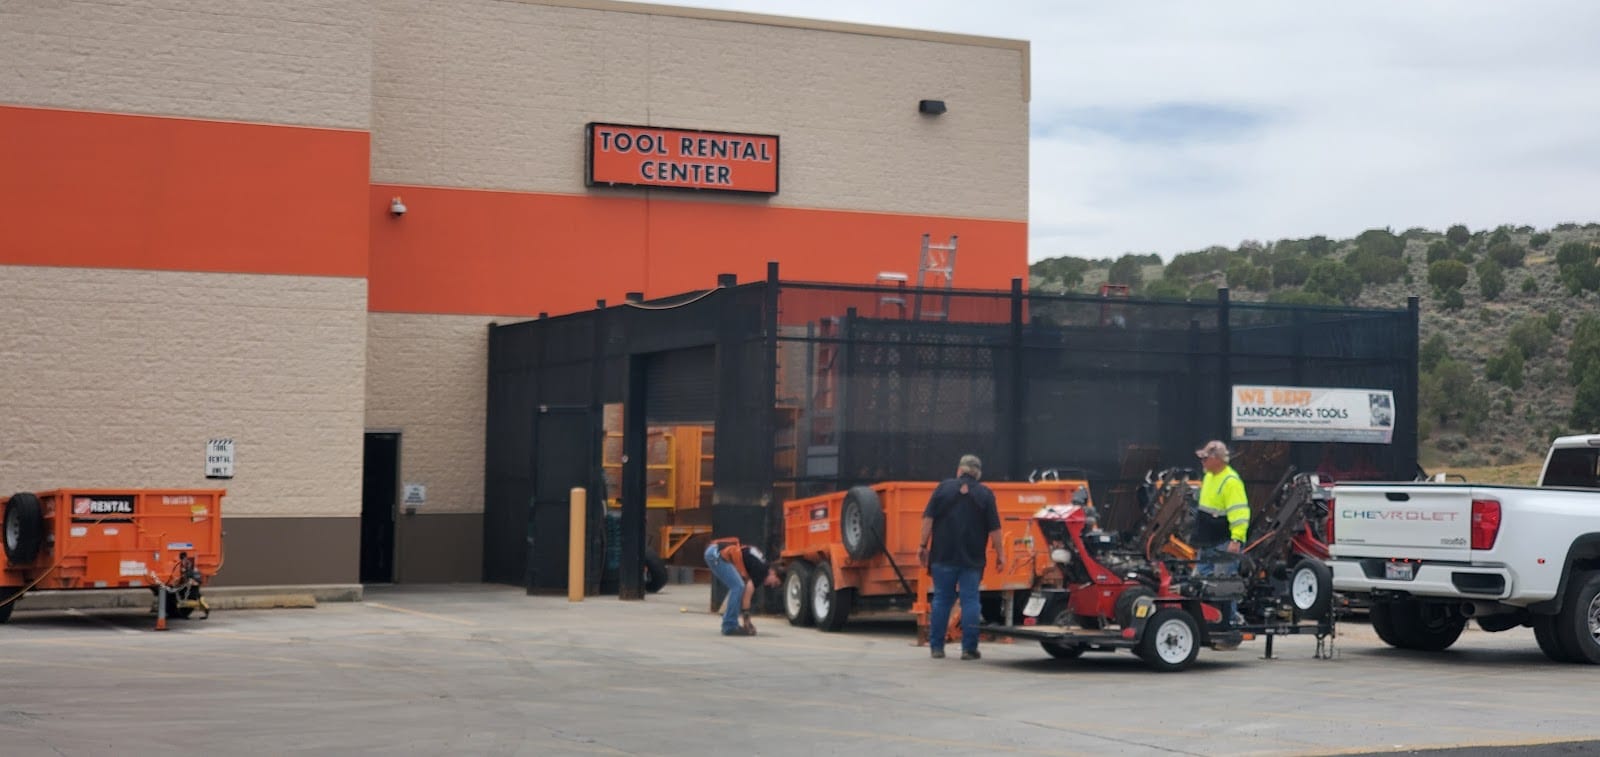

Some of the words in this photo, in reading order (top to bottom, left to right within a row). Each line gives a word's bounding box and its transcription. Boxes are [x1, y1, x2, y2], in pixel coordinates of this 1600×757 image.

[600, 131, 668, 154] TOOL
[680, 136, 771, 162] RENTAL
[640, 161, 731, 185] CENTER
[1238, 389, 1265, 404] WE
[1236, 406, 1313, 418] LANDSCAPING
[1316, 408, 1349, 419] TOOLS
[90, 501, 131, 513] RENTAL
[1342, 509, 1459, 521] CHEVROLET
